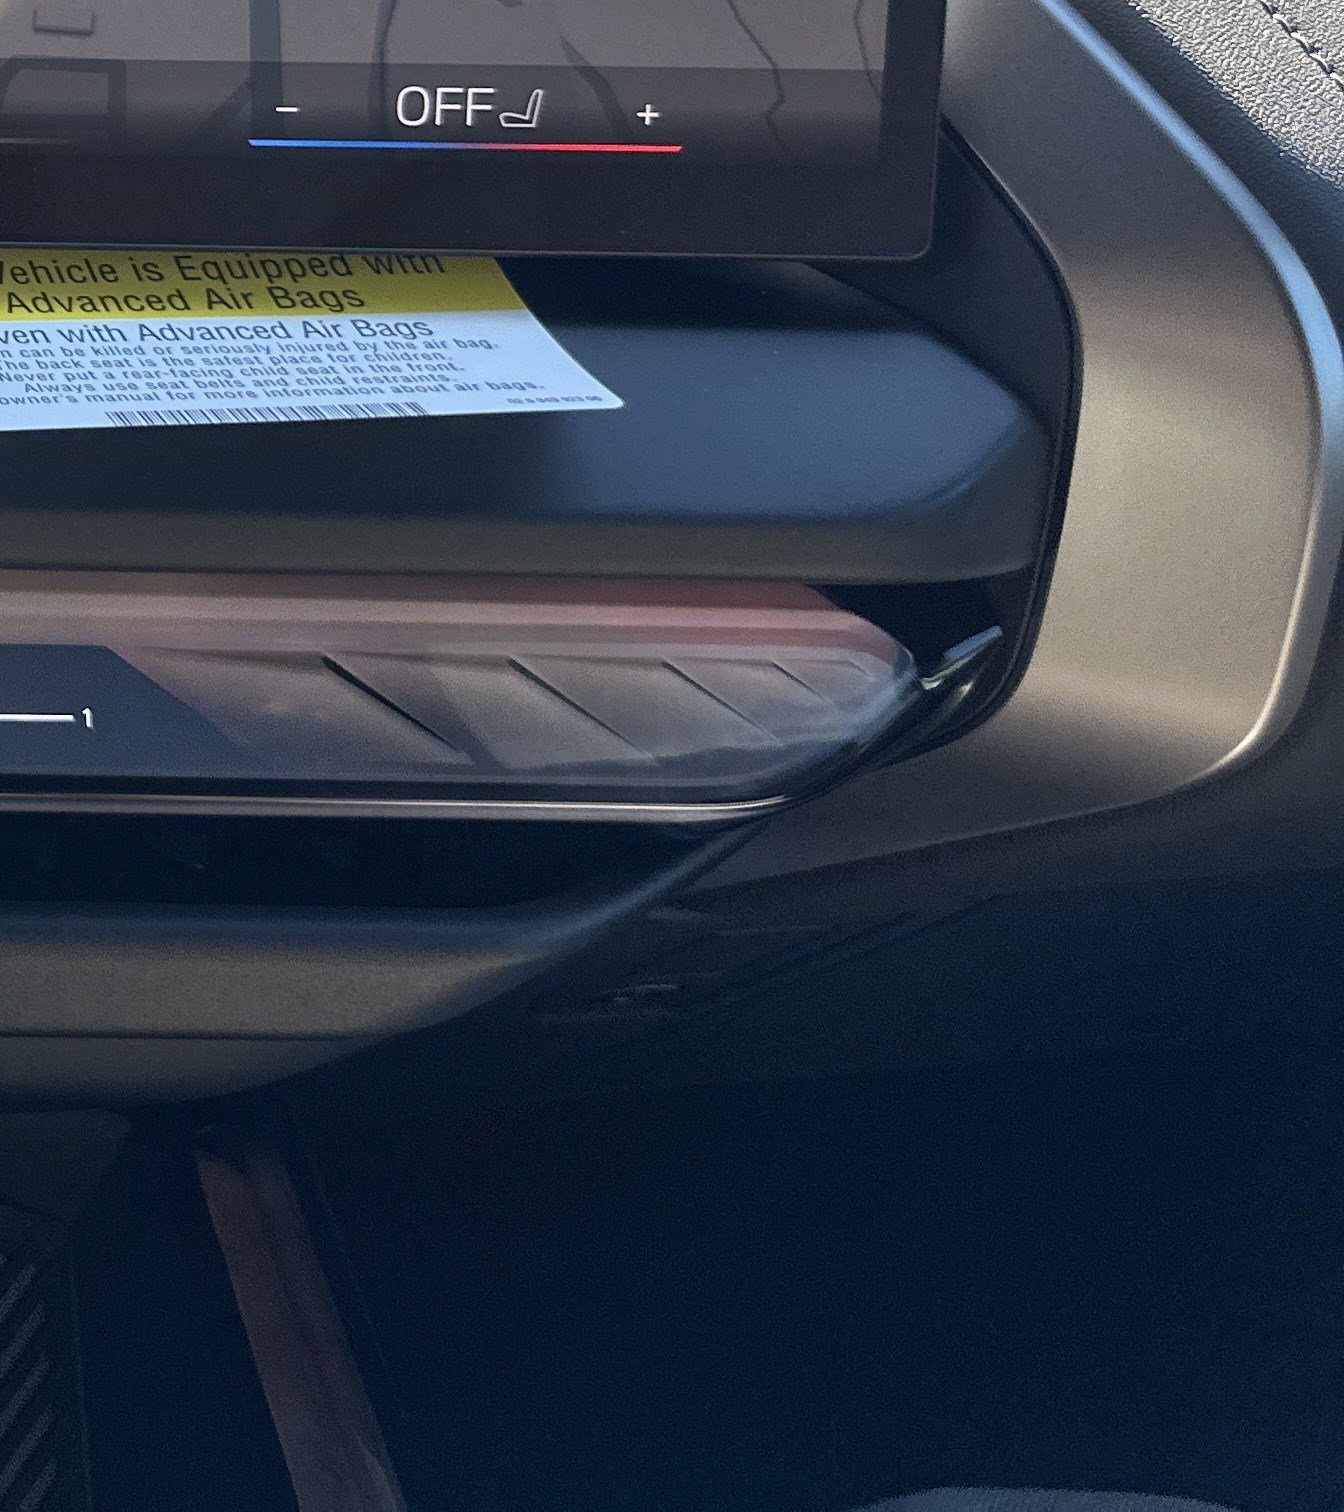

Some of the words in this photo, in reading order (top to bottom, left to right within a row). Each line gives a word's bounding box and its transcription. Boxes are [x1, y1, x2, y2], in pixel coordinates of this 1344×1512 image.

[395, 85, 495, 127] OFF
[127, 256, 165, 283] is
[172, 253, 354, 286] Equipped
[6, 287, 191, 314] Advanced
[205, 286, 255, 311] Air
[265, 285, 365, 313] Bags
[57, 324, 128, 344] with
[137, 320, 292, 342] Advanced
[300, 318, 345, 339] Air
[349, 318, 434, 340] Bags
[19, 348, 55, 359] can
[60, 345, 86, 358] be
[90, 344, 146, 357] killed
[152, 345, 178, 356] or
[180, 342, 271, 356] seriously
[277, 340, 350, 354] injured
[353, 340, 379, 354] by
[385, 339, 418, 351] the
[422, 338, 448, 350] air
[34, 357, 85, 370] back
[89, 357, 134, 369] seat
[138, 356, 158, 368] is
[161, 356, 195, 367] the
[200, 354, 263, 367] safest
[268, 353, 323, 367] place
[327, 352, 358, 364] for
[63, 369, 98, 383] put
[103, 370, 116, 380] a
[123, 367, 235, 380] rear-facing
[239, 365, 290, 378] child
[295, 364, 340, 376] seat
[342, 363, 367, 375] in
[371, 362, 403, 374] the
[24, 382, 96, 394] Always
[102, 382, 139, 392] use
[144, 379, 191, 391] seat
[193, 377, 247, 389] belts
[251, 376, 290, 388] and
[295, 374, 346, 387] child
[84, 390, 161, 404] manual
[165, 389, 197, 401] for
[204, 389, 259, 400] more
[263, 384, 386, 399] information
[390, 382, 448, 395] about
[452, 380, 480, 393] air
[81, 707, 94, 730] 1
